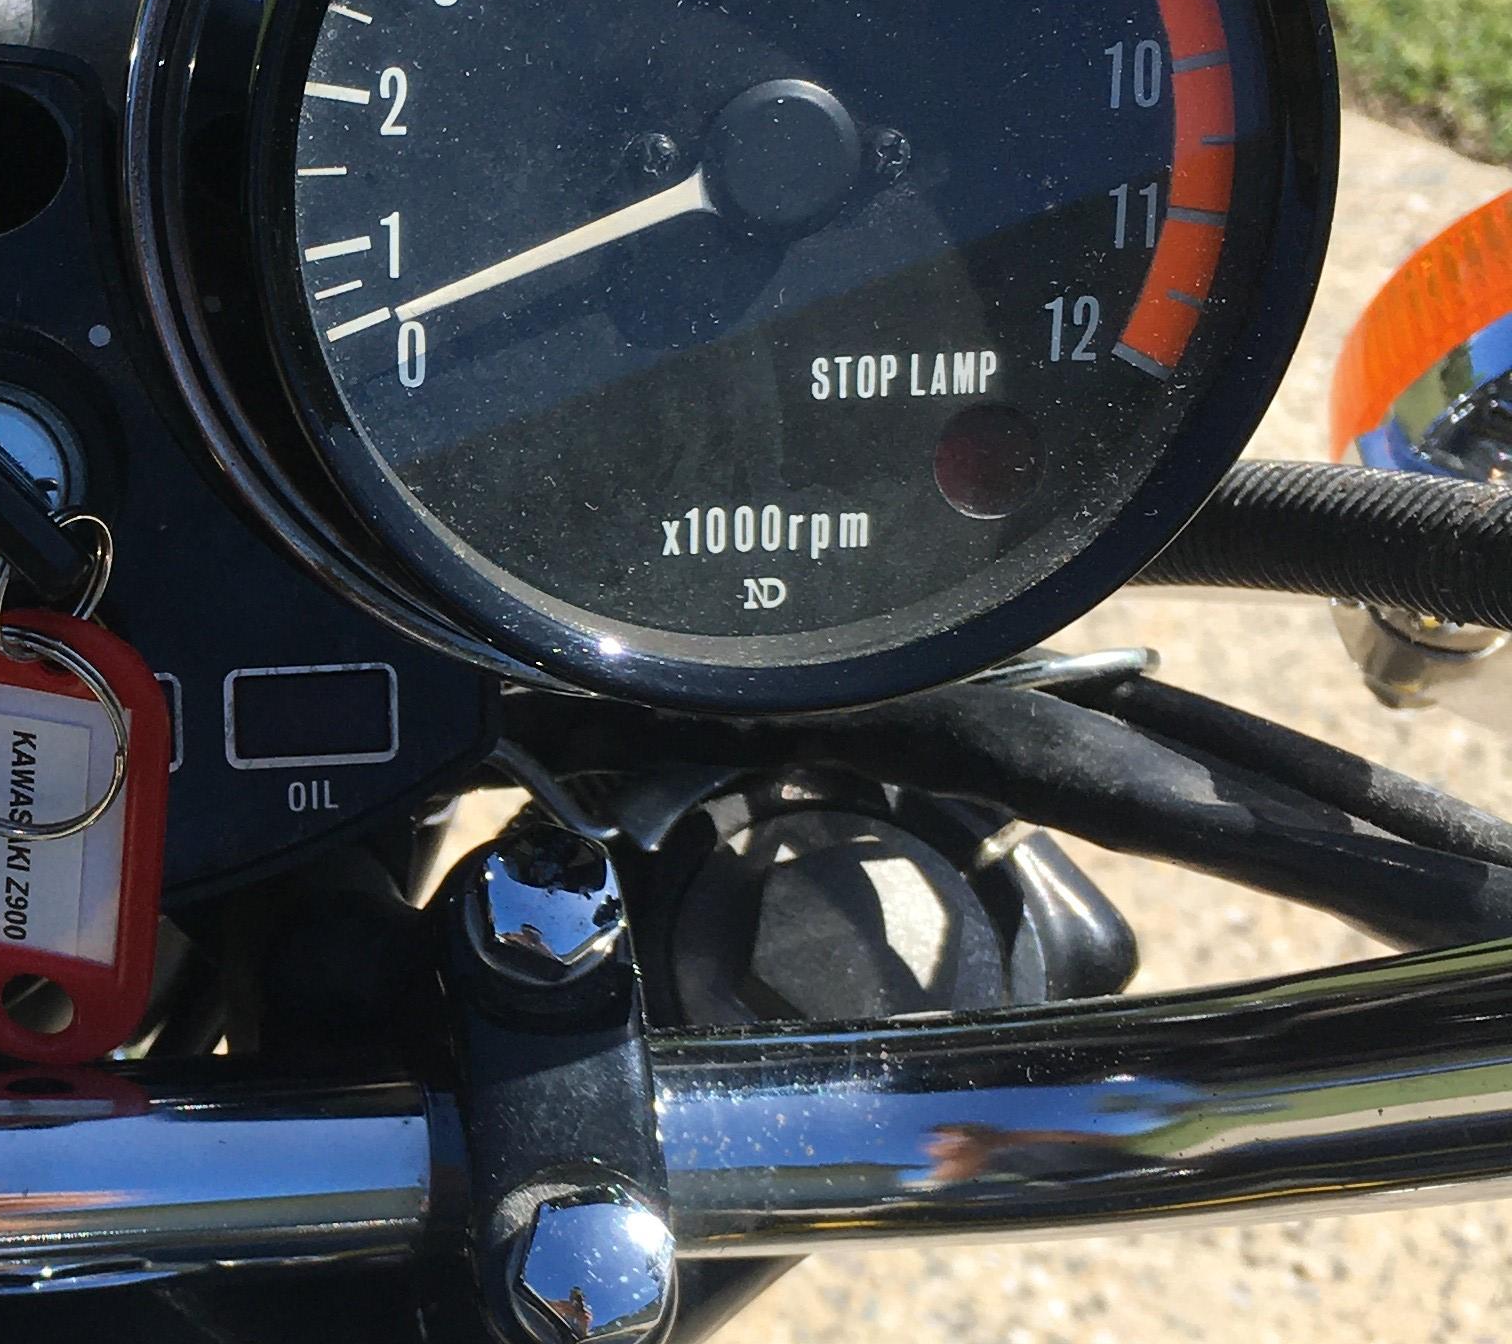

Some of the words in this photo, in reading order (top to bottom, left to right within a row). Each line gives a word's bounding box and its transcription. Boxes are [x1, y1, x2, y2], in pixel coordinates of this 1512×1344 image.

[379, 67, 408, 136] 2
[1105, 39, 1162, 110] 10
[379, 211, 401, 279] 1
[1107, 182, 1159, 250] 11
[397, 321, 426, 388] 0
[1044, 295, 1101, 363] 12
[811, 354, 898, 401] STOP
[910, 350, 997, 398] LAMP
[662, 504, 870, 560] x1000rpm
[742, 577, 787, 610] ND
[7, 730, 37, 873] KAWASKI
[288, 780, 339, 814] OIL
[2, 876, 30, 941] Z900
